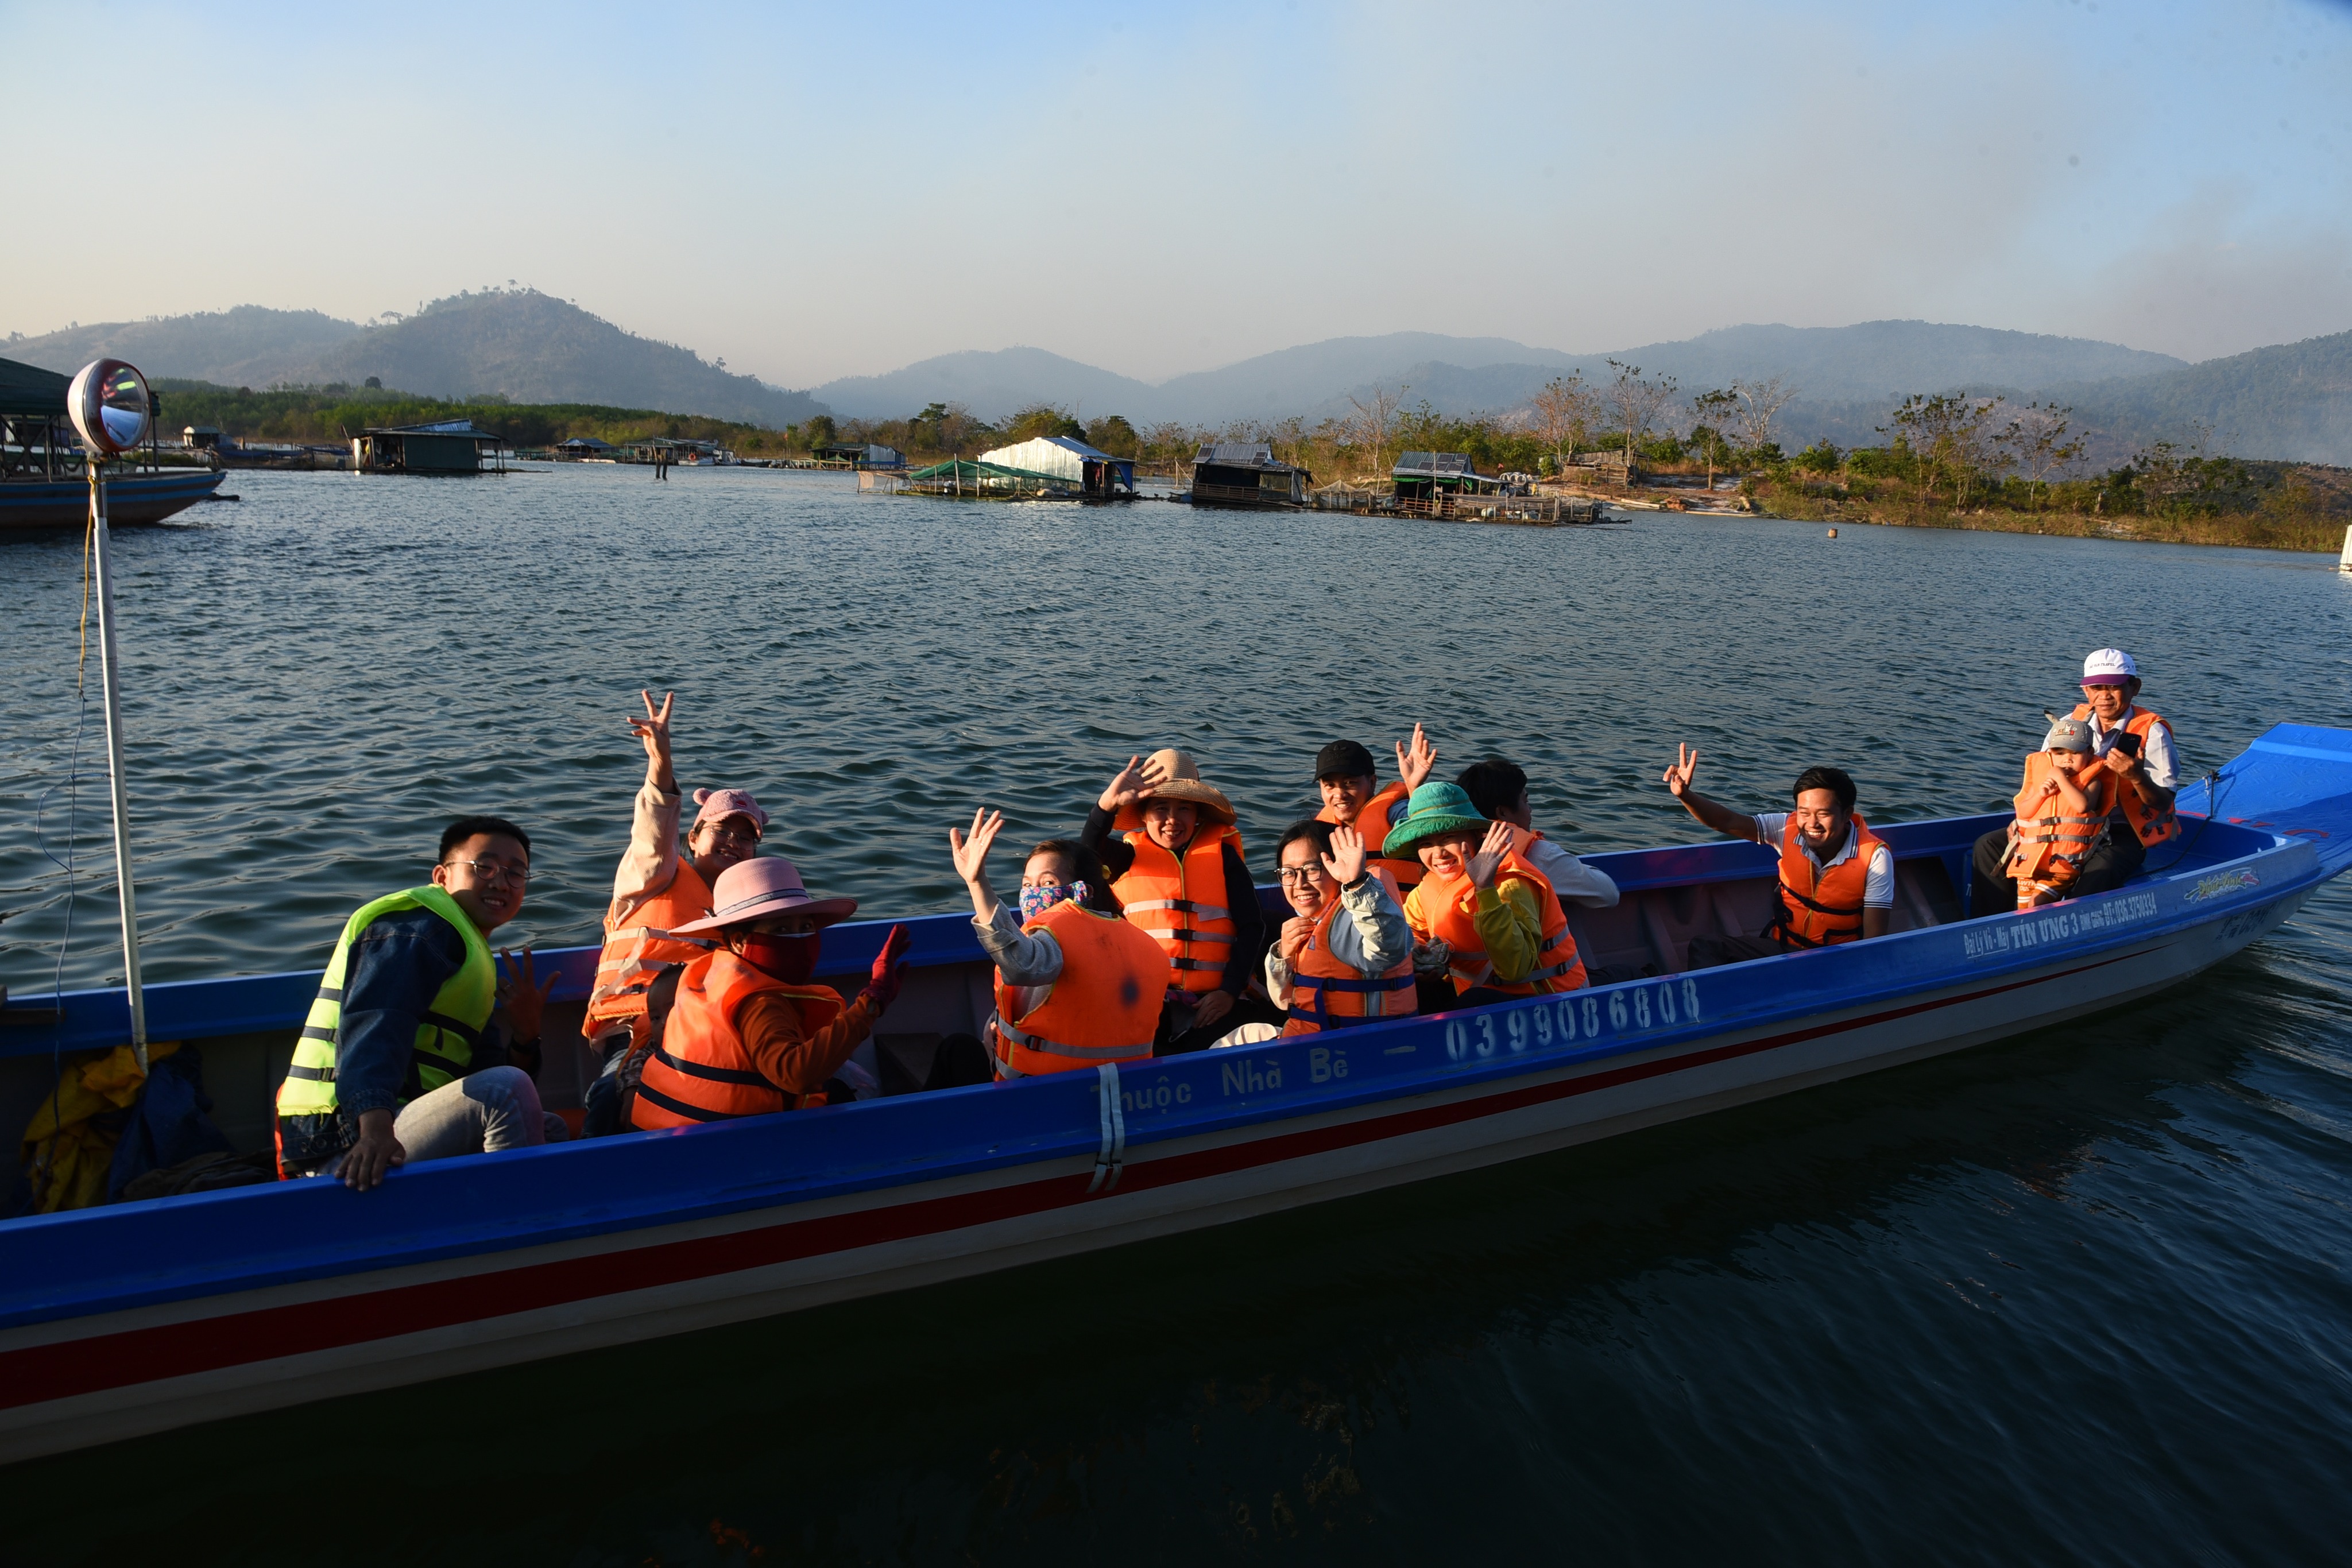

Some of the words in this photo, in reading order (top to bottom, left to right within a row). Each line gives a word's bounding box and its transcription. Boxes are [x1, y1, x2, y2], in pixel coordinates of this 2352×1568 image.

[2010, 919, 2037, 948] TÍN
[2038, 915, 2069, 942] ƯNG
[2070, 912, 2079, 935] 3
[1222, 1059, 1282, 1096] Nhà
[1309, 1047, 1348, 1083] Bè
